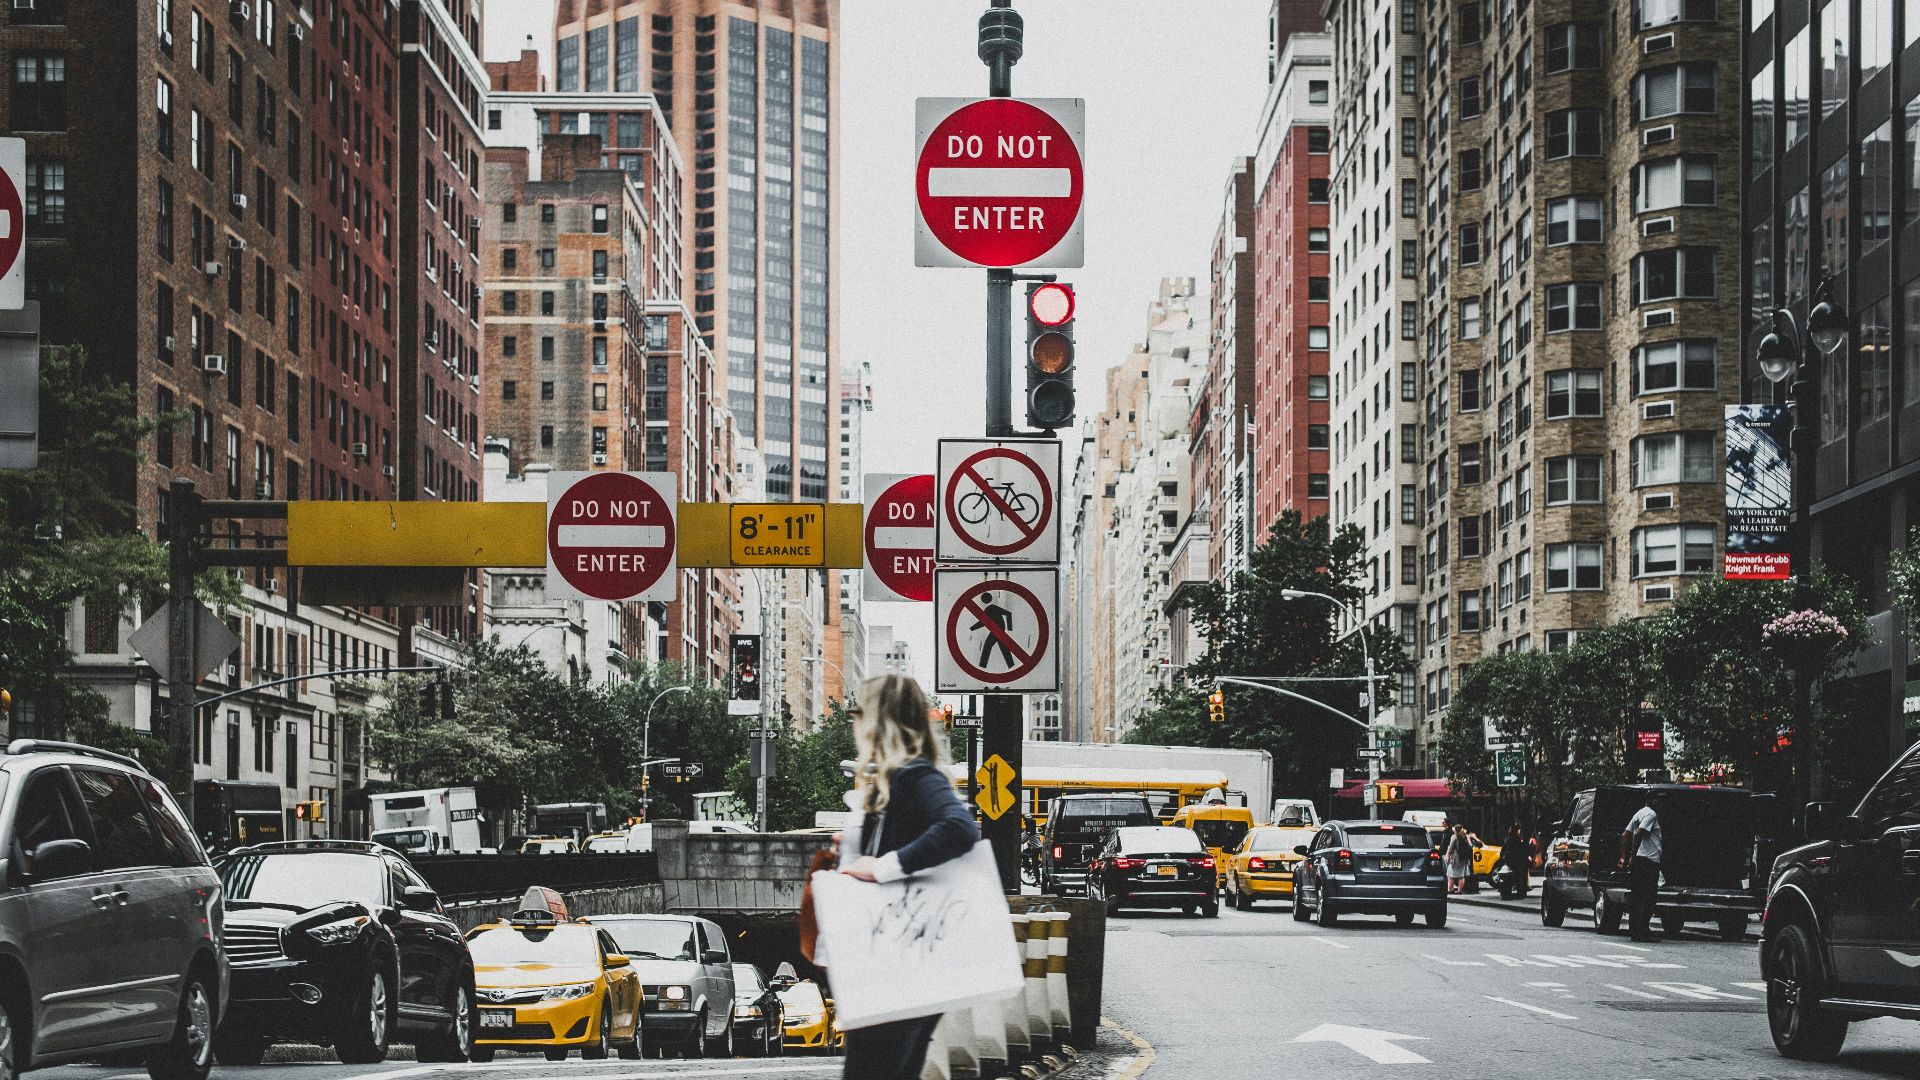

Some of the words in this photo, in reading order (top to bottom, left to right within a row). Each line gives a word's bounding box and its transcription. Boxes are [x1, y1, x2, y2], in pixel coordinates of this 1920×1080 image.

[947, 135, 983, 159] DO
[997, 135, 1052, 159] NOT
[954, 206, 1045, 230] ENTER
[572, 500, 599, 518] DO
[610, 500, 651, 518] NOT
[888, 502, 915, 520] DO
[744, 546, 811, 556] CLEARANCE
[1725, 555, 1763, 564] Newmark
[1764, 555, 1789, 564] Grubb
[577, 554, 645, 572] ENTER
[893, 556, 934, 574] ENT
[1725, 565, 1751, 575] Knight
[1753, 565, 1776, 573] Frank
